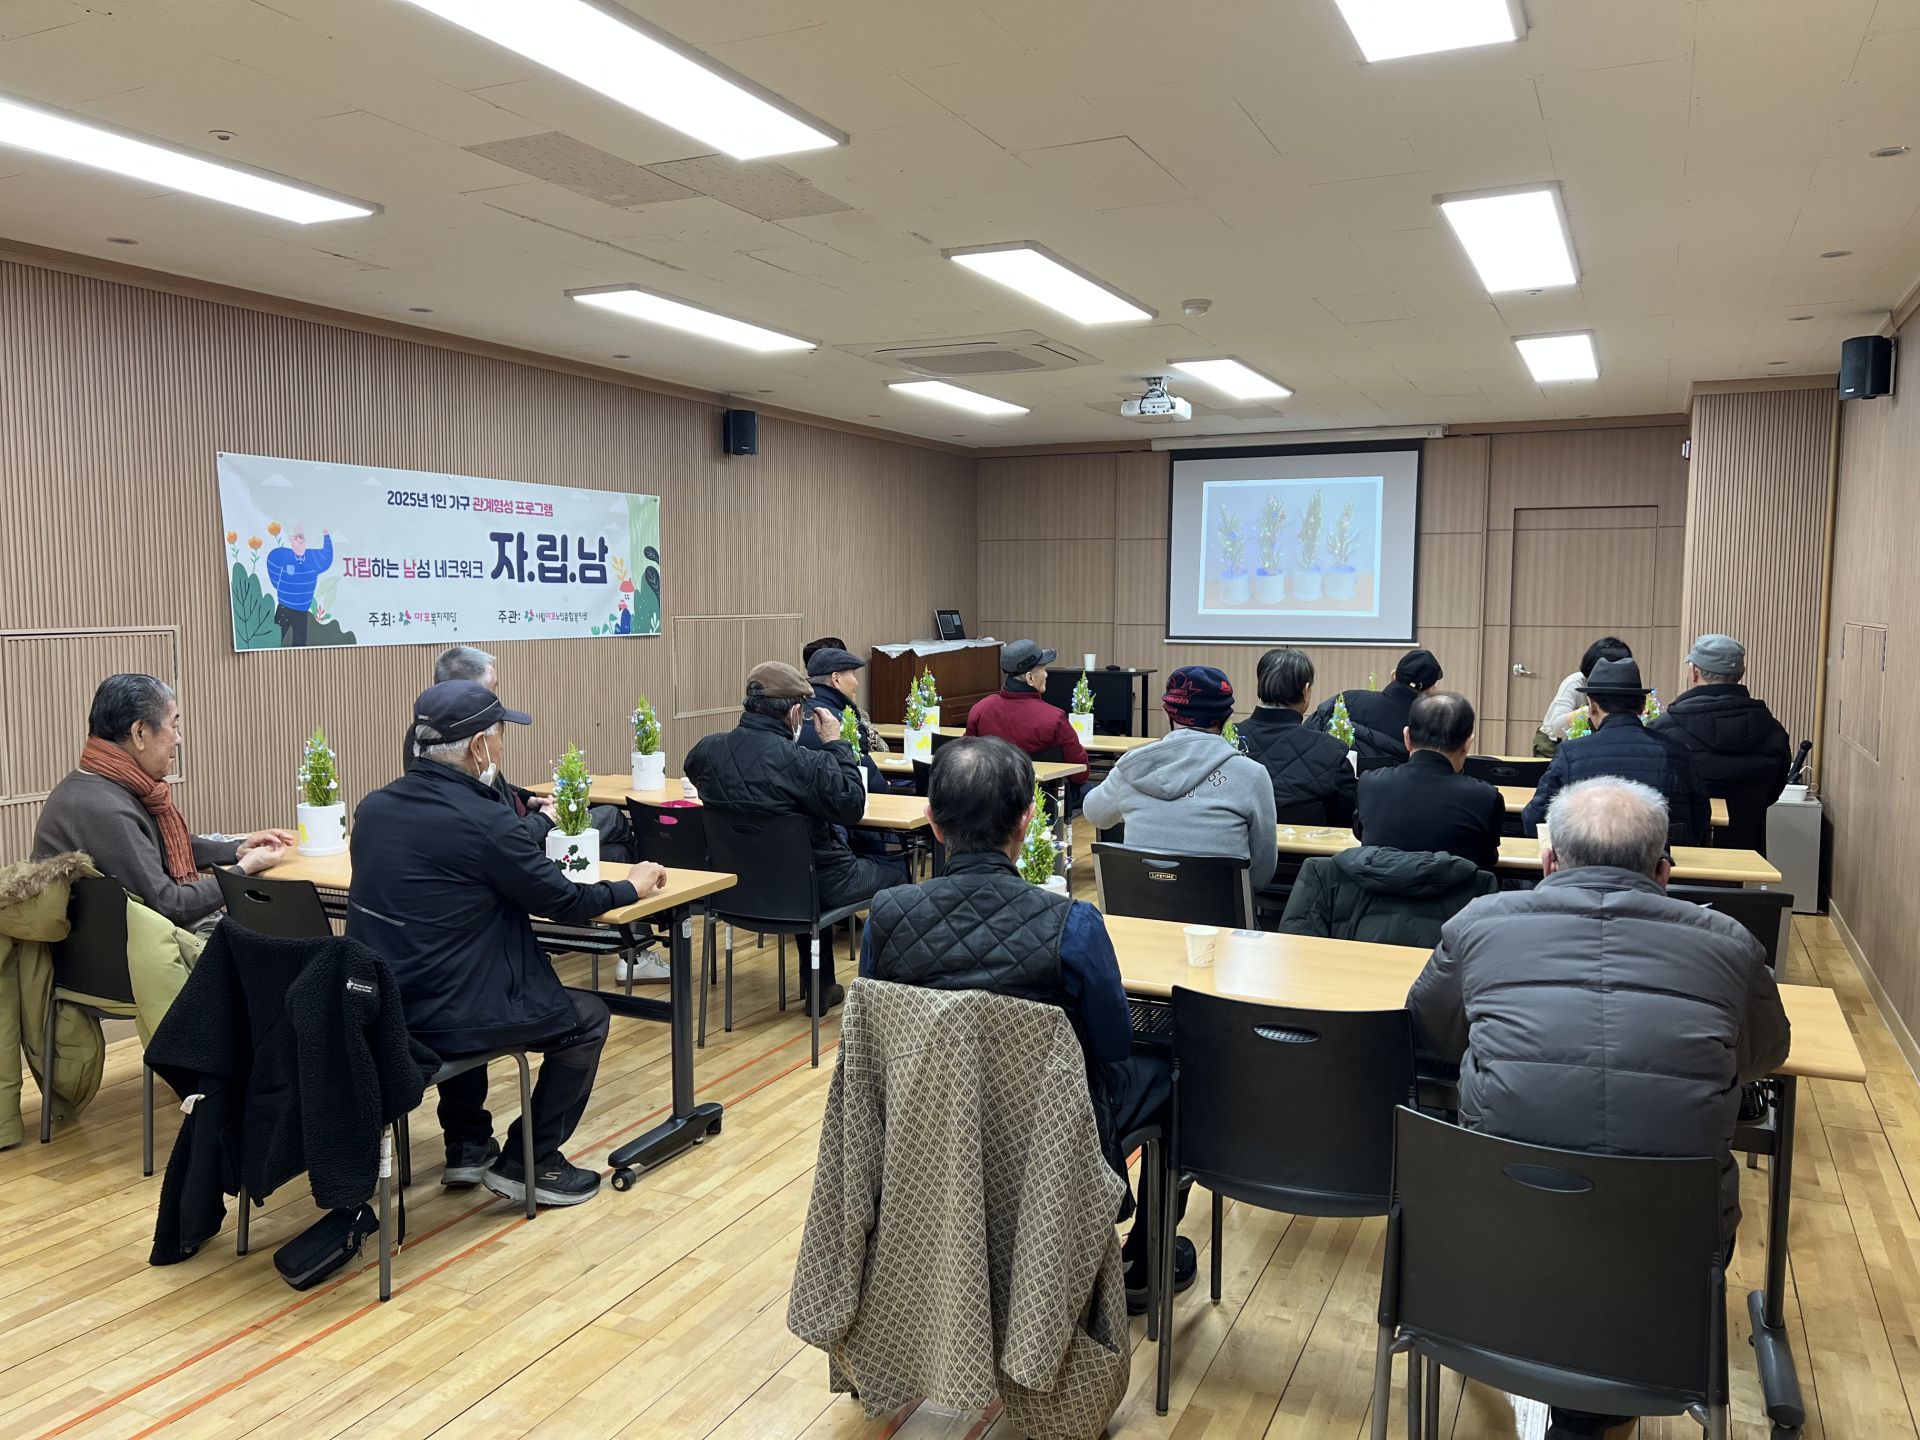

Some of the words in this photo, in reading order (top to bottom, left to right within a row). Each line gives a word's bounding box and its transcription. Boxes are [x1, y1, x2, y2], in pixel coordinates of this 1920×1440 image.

[387, 490, 429, 509] 2025년
[430, 493, 447, 509] 1인
[449, 495, 470, 511] 가구
[472, 496, 514, 514] 관계형성
[515, 500, 554, 517] 프로그램
[343, 557, 399, 578] 자립하는
[403, 558, 431, 579] 남성
[434, 559, 484, 579] 네크워크
[489, 531, 608, 584] 자.립.남
[368, 612, 396, 627] 주최:
[414, 611, 457, 627] 마포복지재단
[498, 610, 521, 624] 주관:
